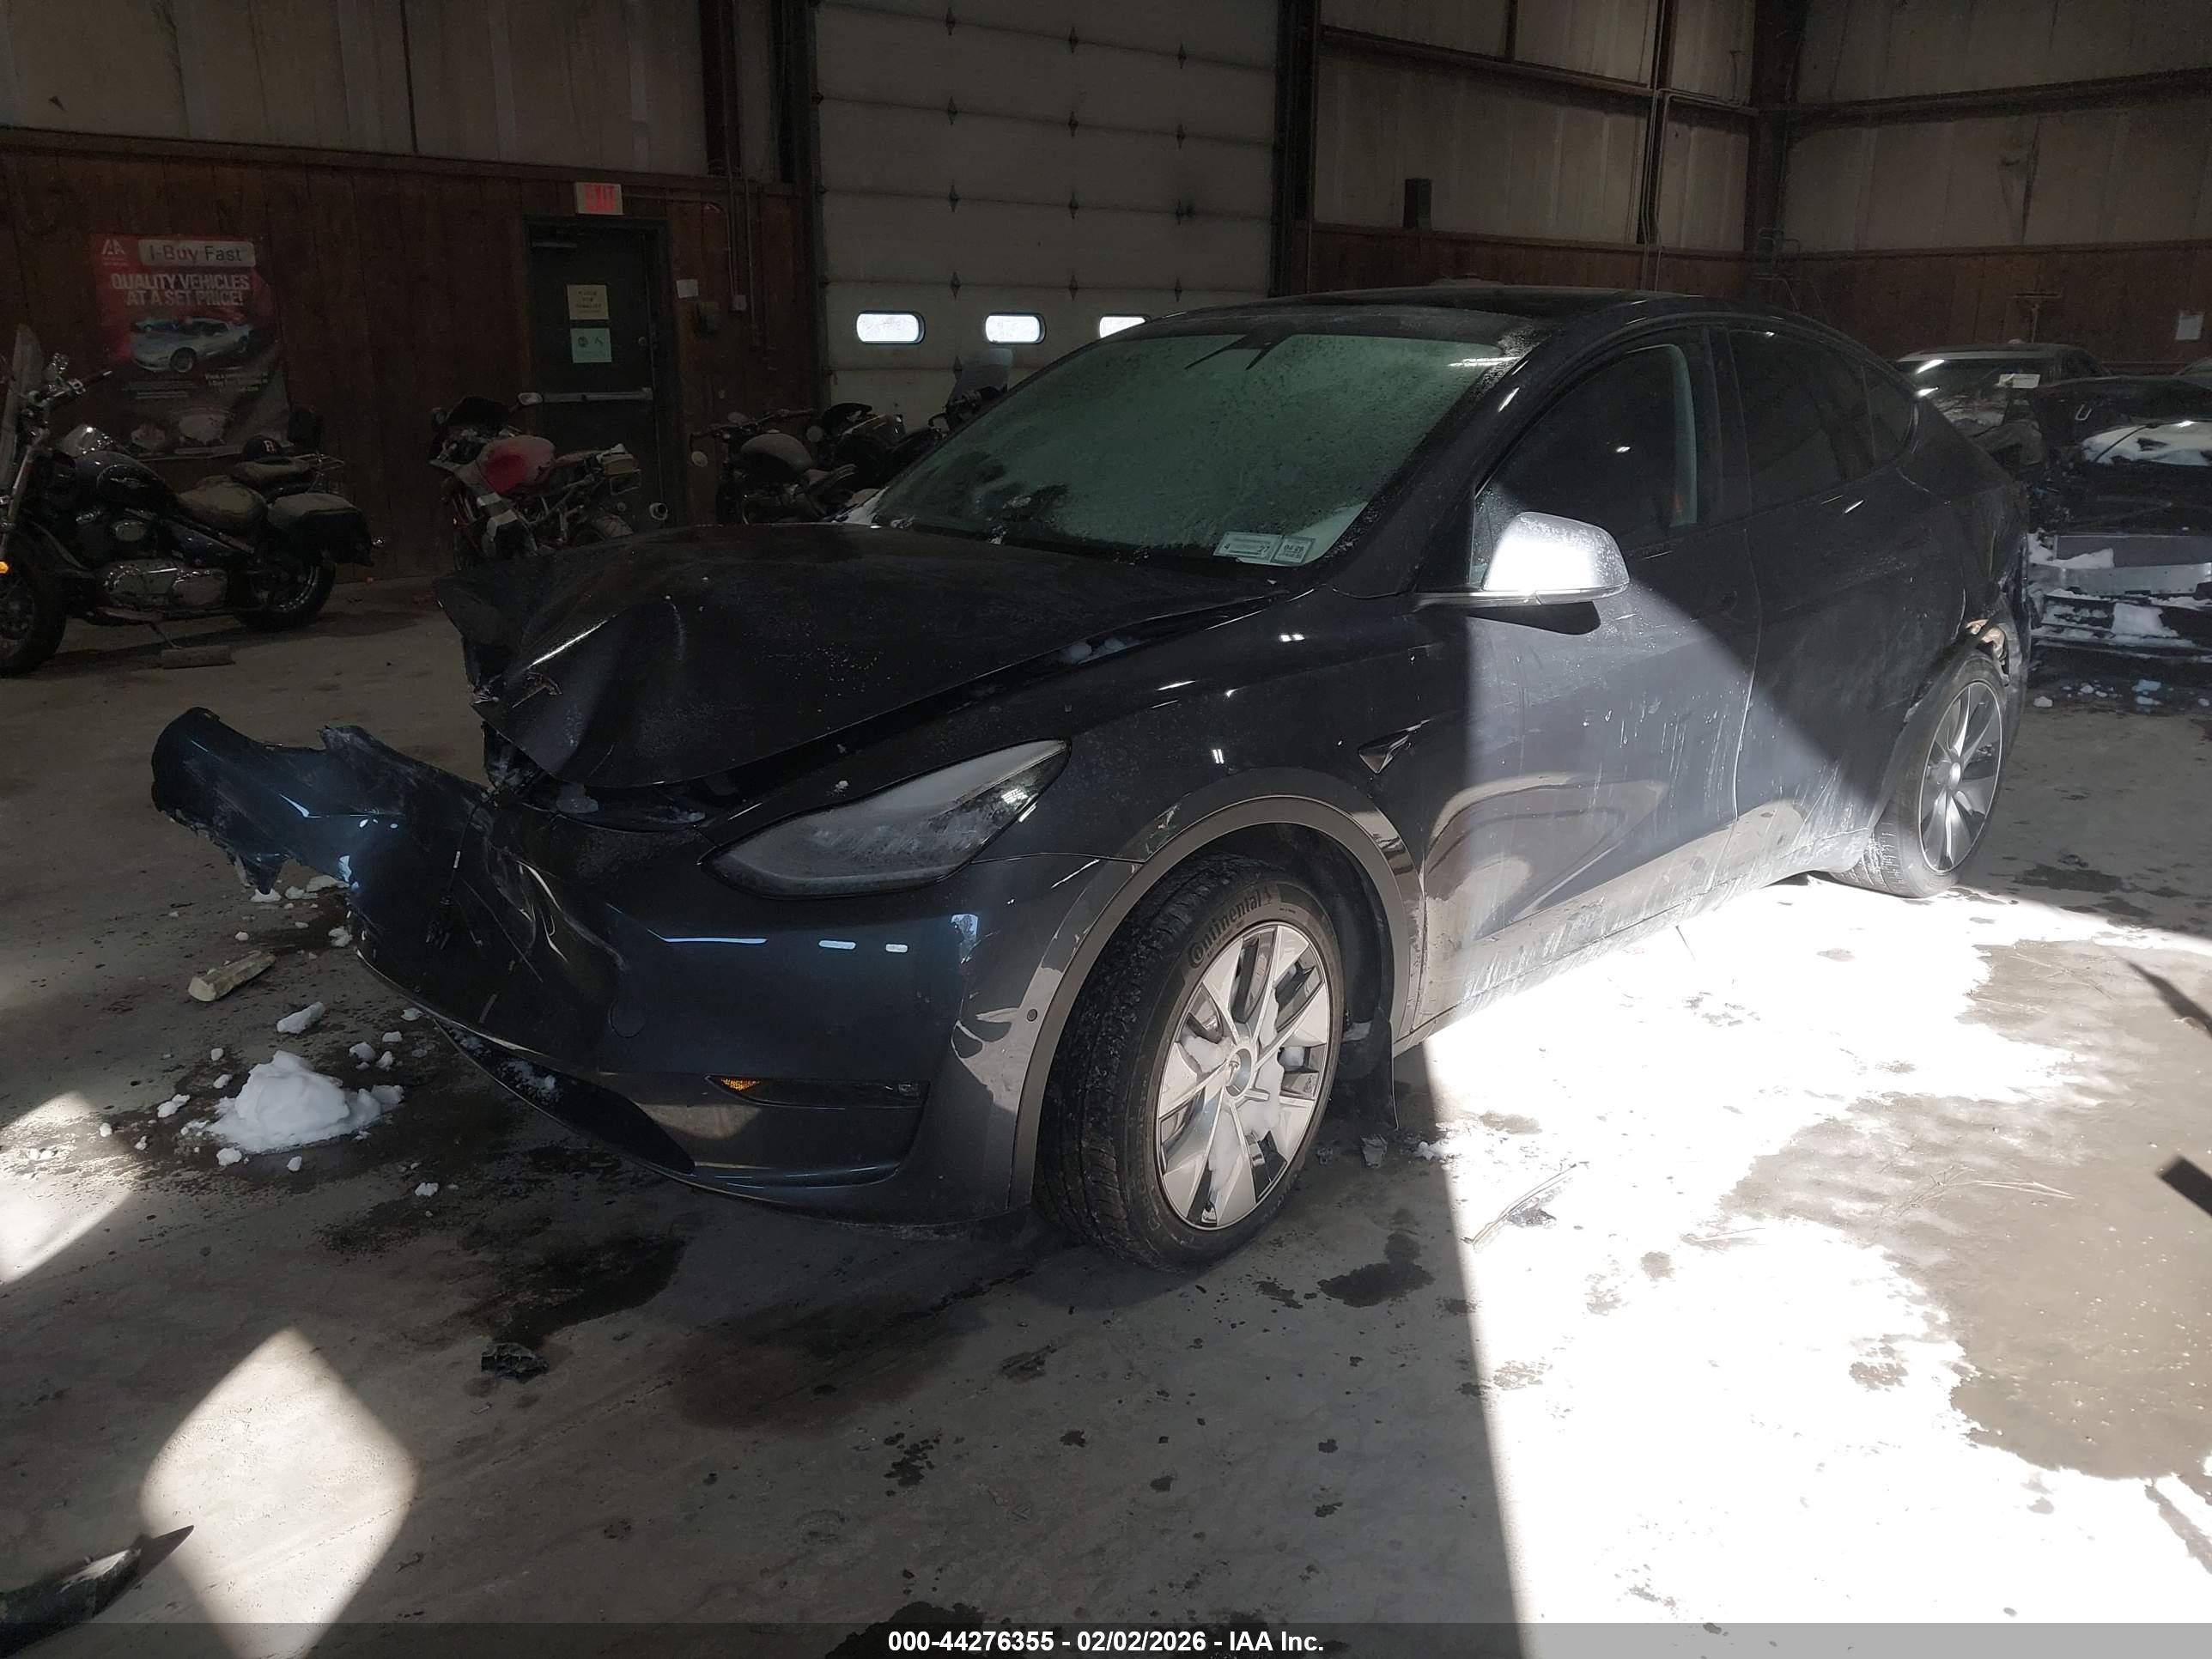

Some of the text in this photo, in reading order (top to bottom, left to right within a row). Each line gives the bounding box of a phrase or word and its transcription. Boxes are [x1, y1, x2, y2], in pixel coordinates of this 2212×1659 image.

[204, 245, 243, 262] Fast
[110, 272, 251, 290] QUALITY VEHICLES
[126, 290, 244, 306] AT A SET PRICE!
[1189, 890, 1262, 969] Continental
